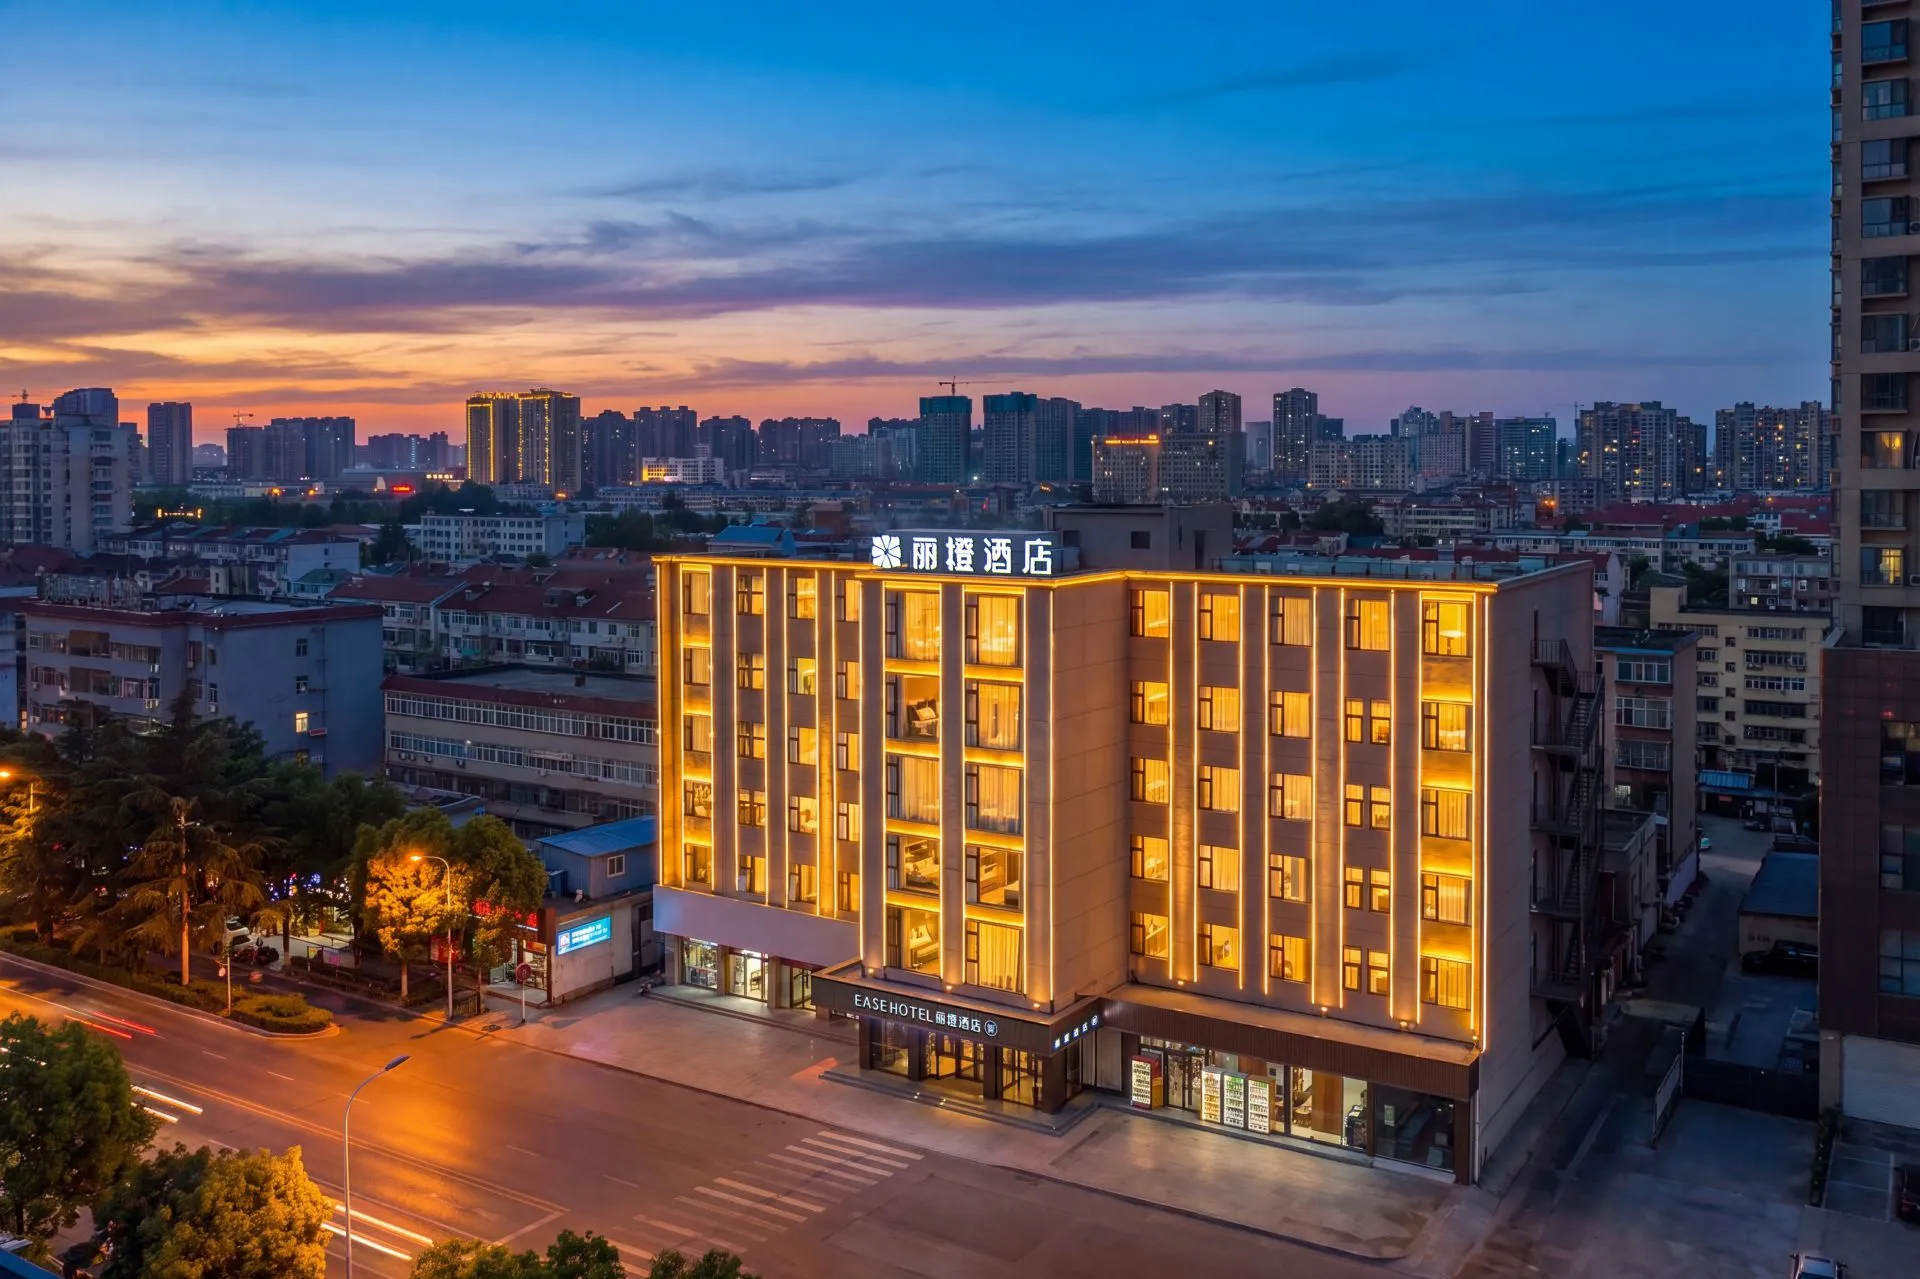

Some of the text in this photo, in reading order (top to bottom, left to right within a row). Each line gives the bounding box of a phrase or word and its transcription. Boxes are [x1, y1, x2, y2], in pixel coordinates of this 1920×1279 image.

[912, 537, 1052, 575] 丽橙酒店
[935, 1010, 981, 1033] 丽橙酒店
